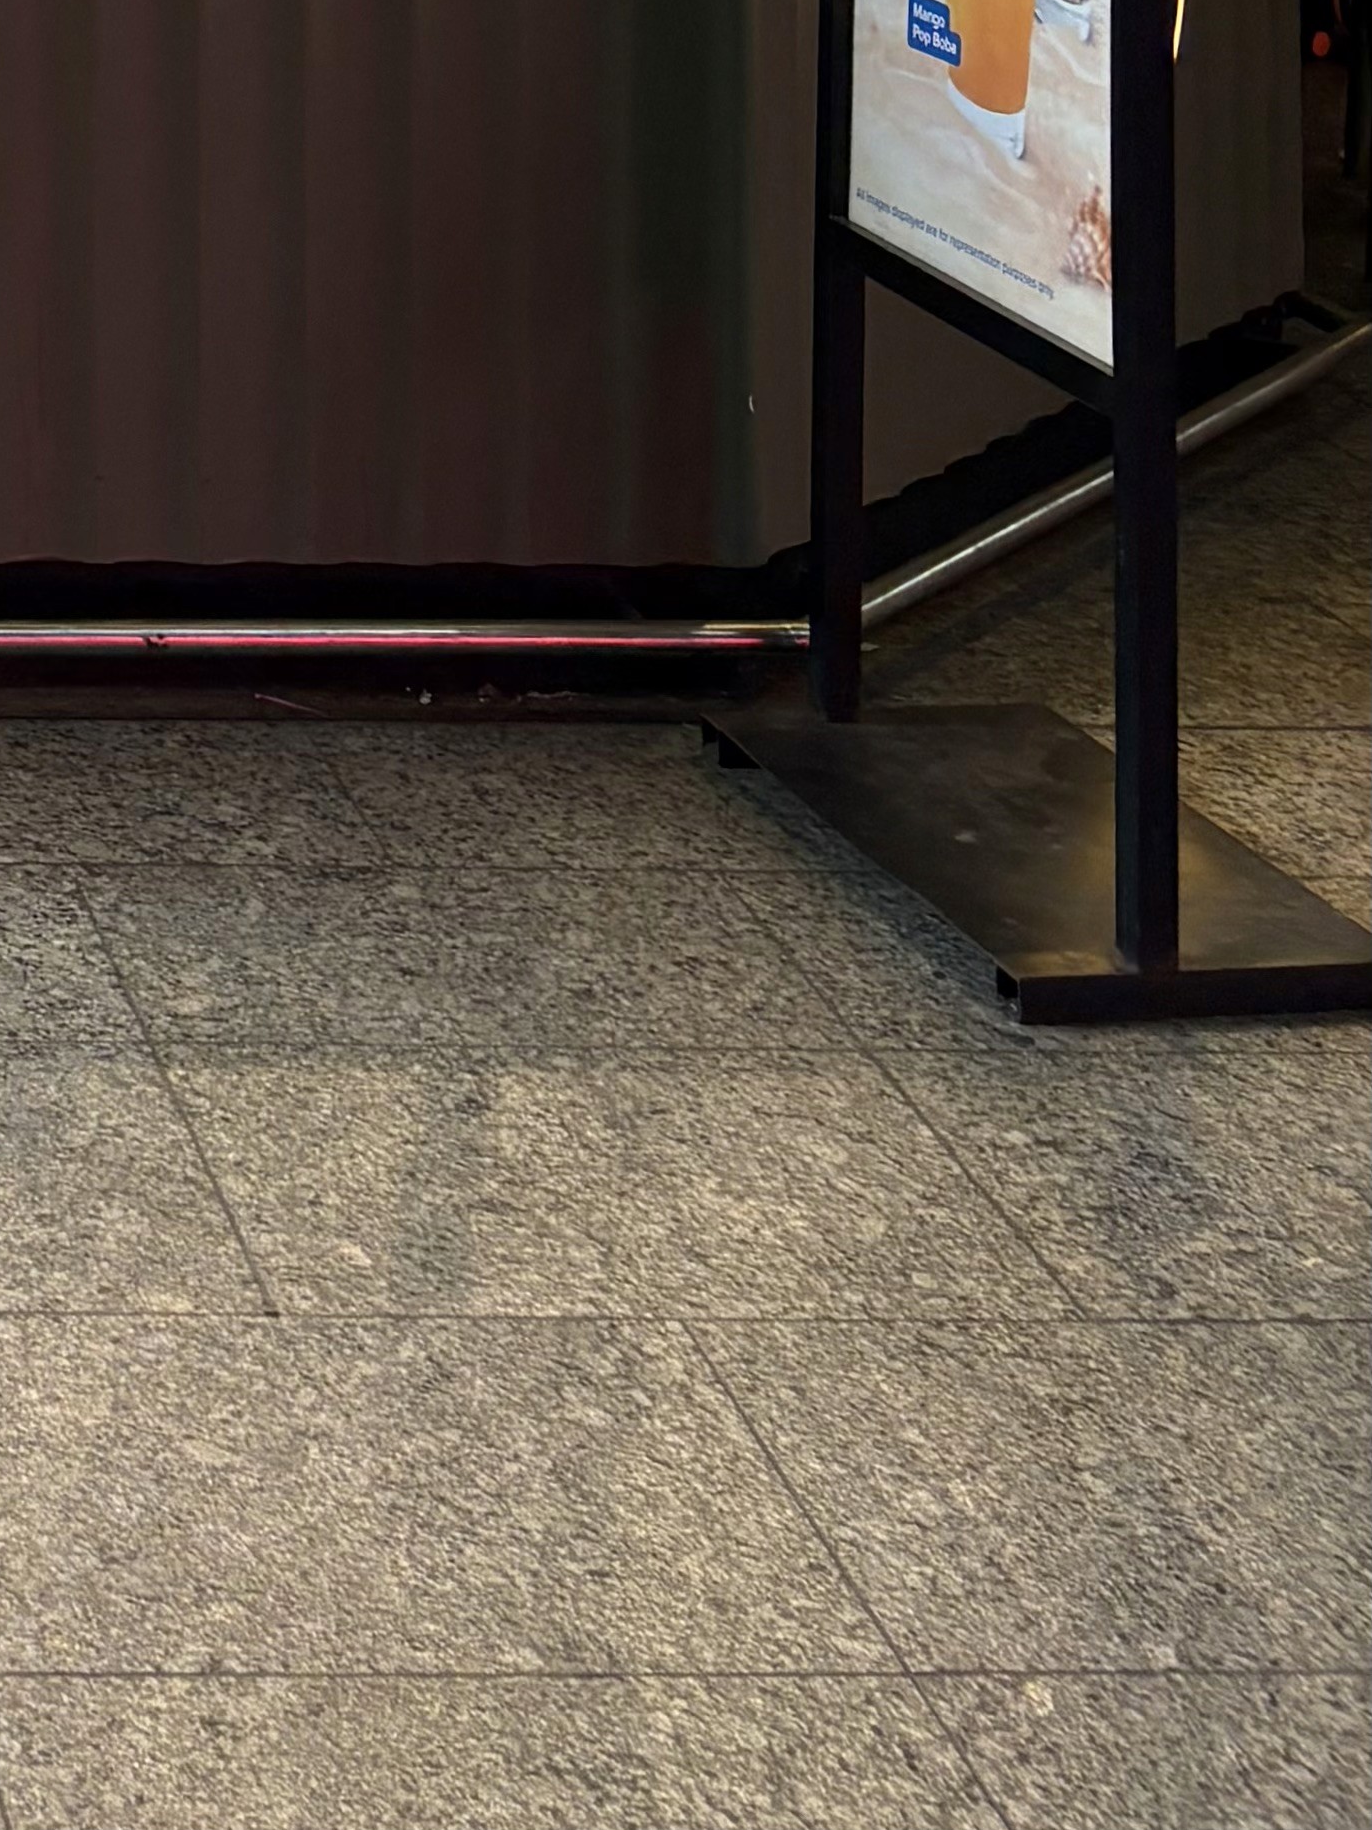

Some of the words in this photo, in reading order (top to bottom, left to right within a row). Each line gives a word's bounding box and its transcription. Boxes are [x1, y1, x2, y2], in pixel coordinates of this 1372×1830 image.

[912, 2, 946, 29] Mango
[912, 23, 932, 46] Pop
[932, 28, 958, 56] Boba
